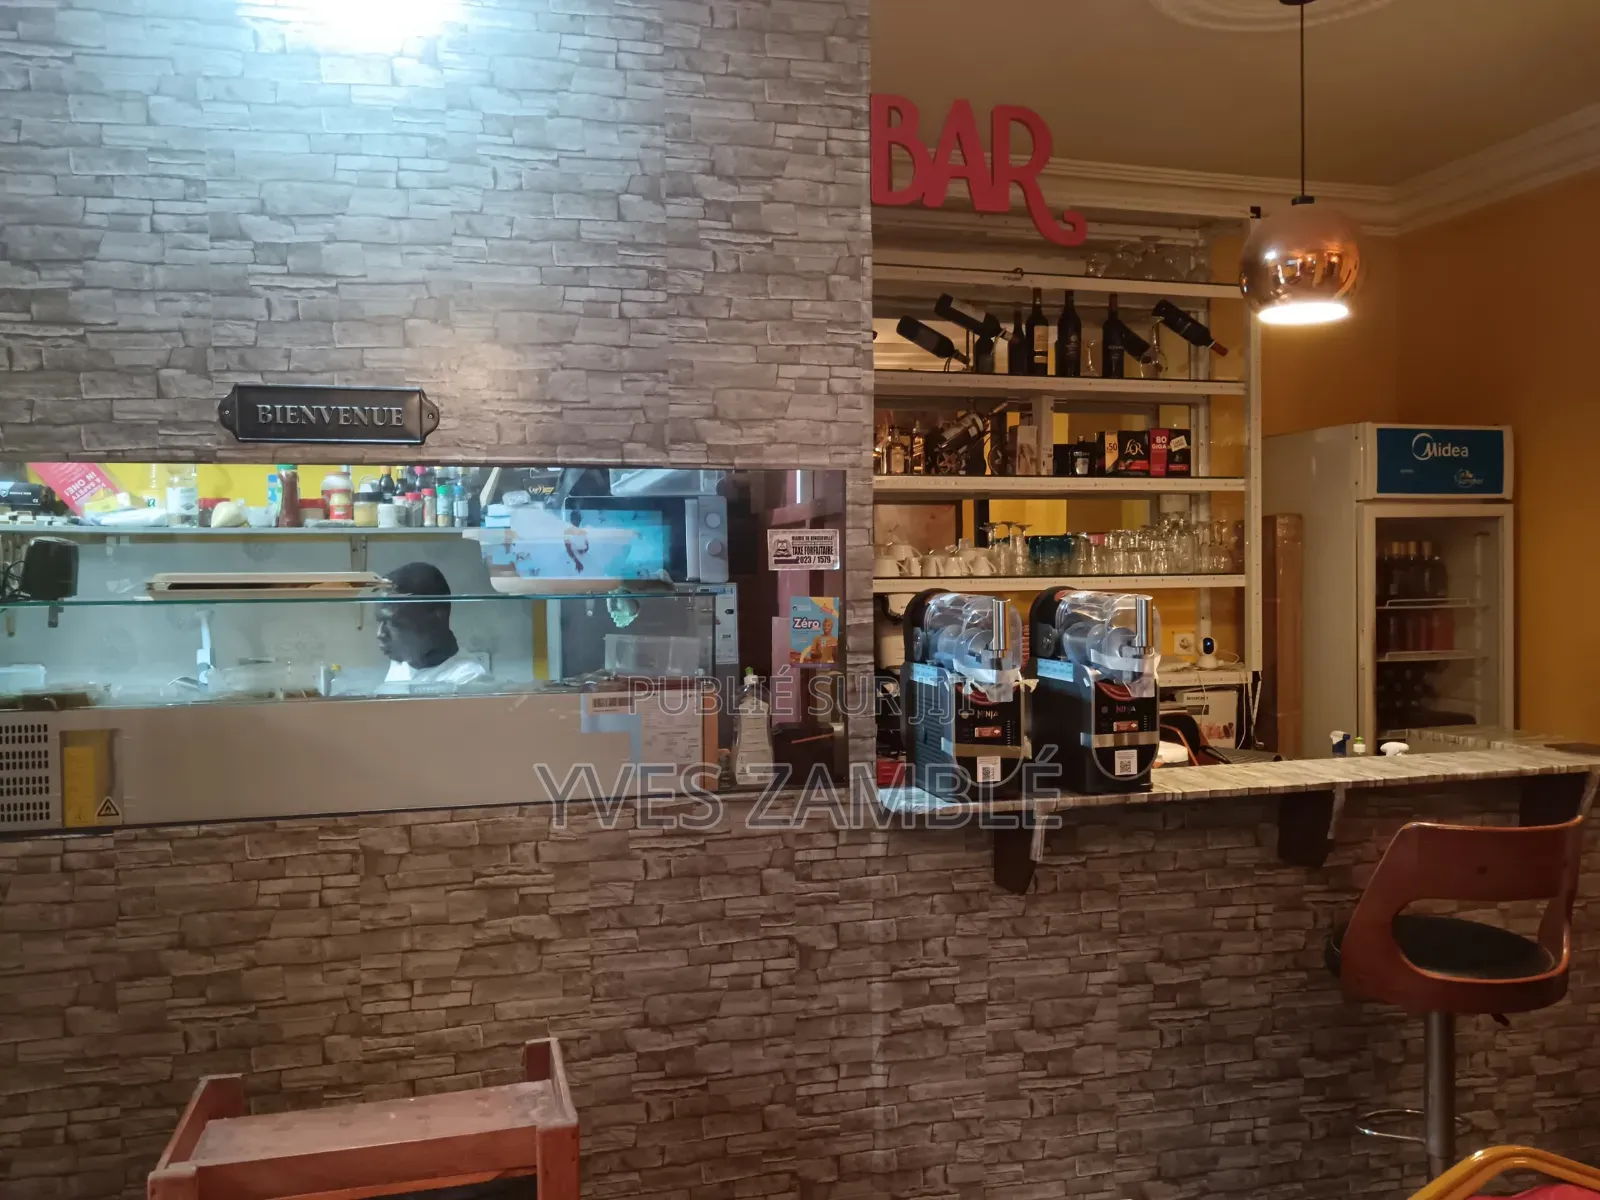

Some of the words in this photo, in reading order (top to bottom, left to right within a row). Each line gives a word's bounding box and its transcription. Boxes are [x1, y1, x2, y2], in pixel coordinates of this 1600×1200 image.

[870, 93, 1087, 246] BAR
[256, 404, 404, 426] BIENVENUE
[1155, 436, 1167, 444] 80
[1417, 438, 1469, 458] Midea
[792, 546, 804, 555] TAXE
[804, 546, 833, 555] FORFAITAIRE
[817, 555, 831, 564] 1579
[793, 617, 820, 629] Zéro
